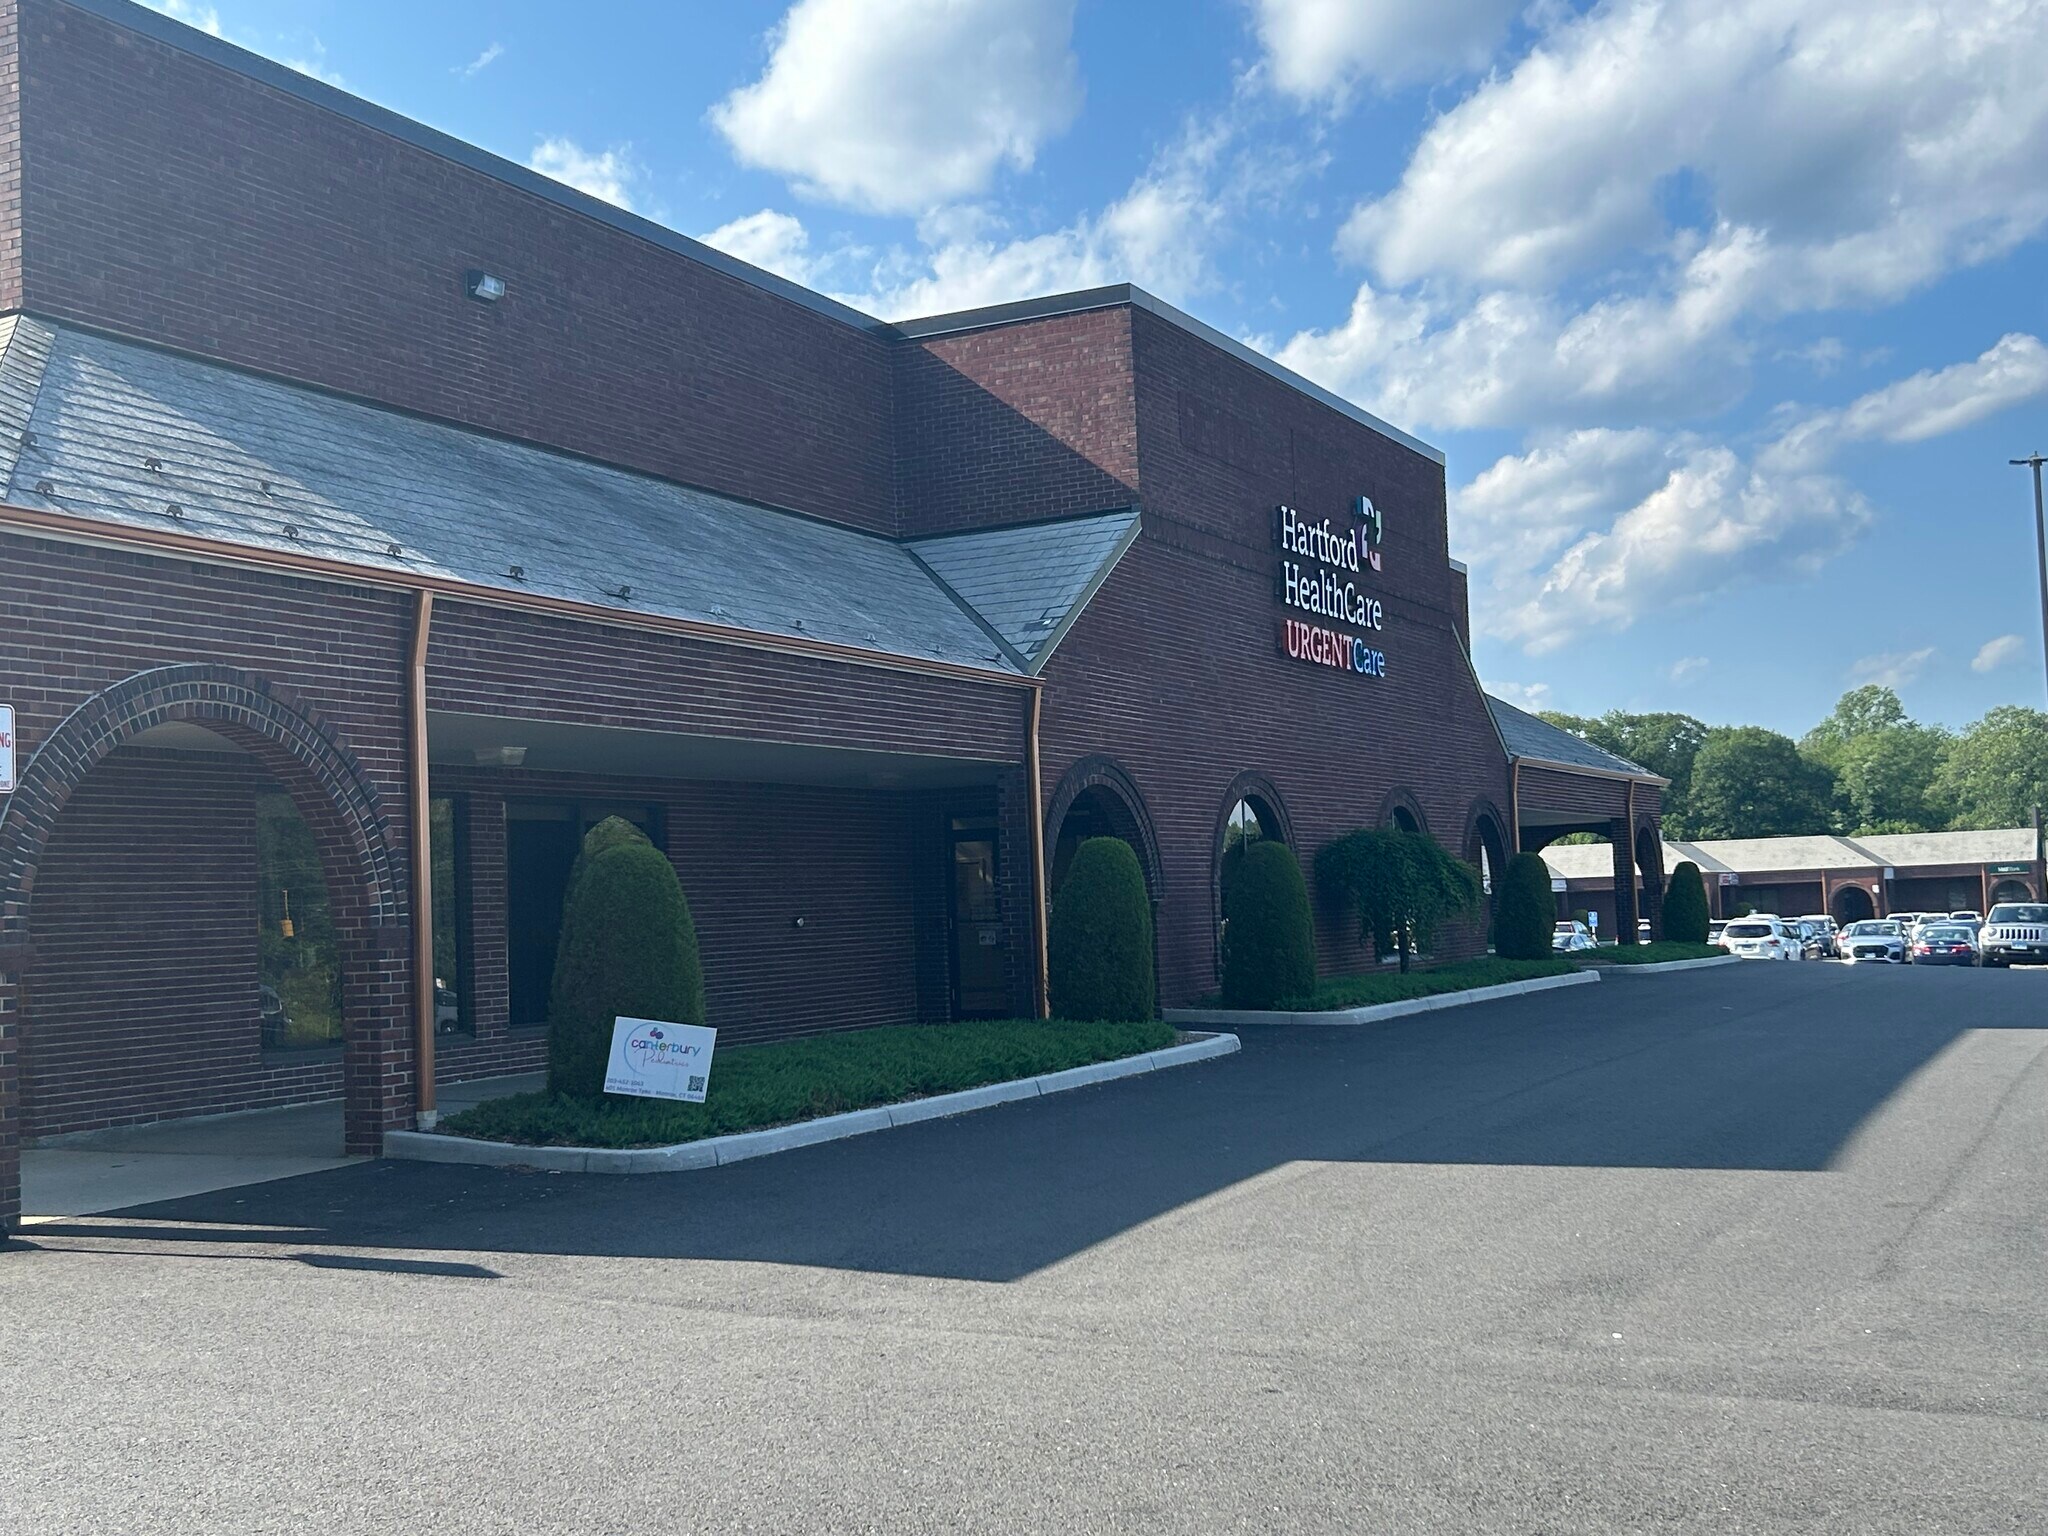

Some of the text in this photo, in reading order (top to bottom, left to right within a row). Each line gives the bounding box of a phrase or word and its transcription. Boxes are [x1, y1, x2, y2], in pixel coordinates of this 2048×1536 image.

[1281, 505, 1359, 572] Hartford
[1283, 560, 1382, 631] HealthCare
[631, 1039, 701, 1057] canterbury
